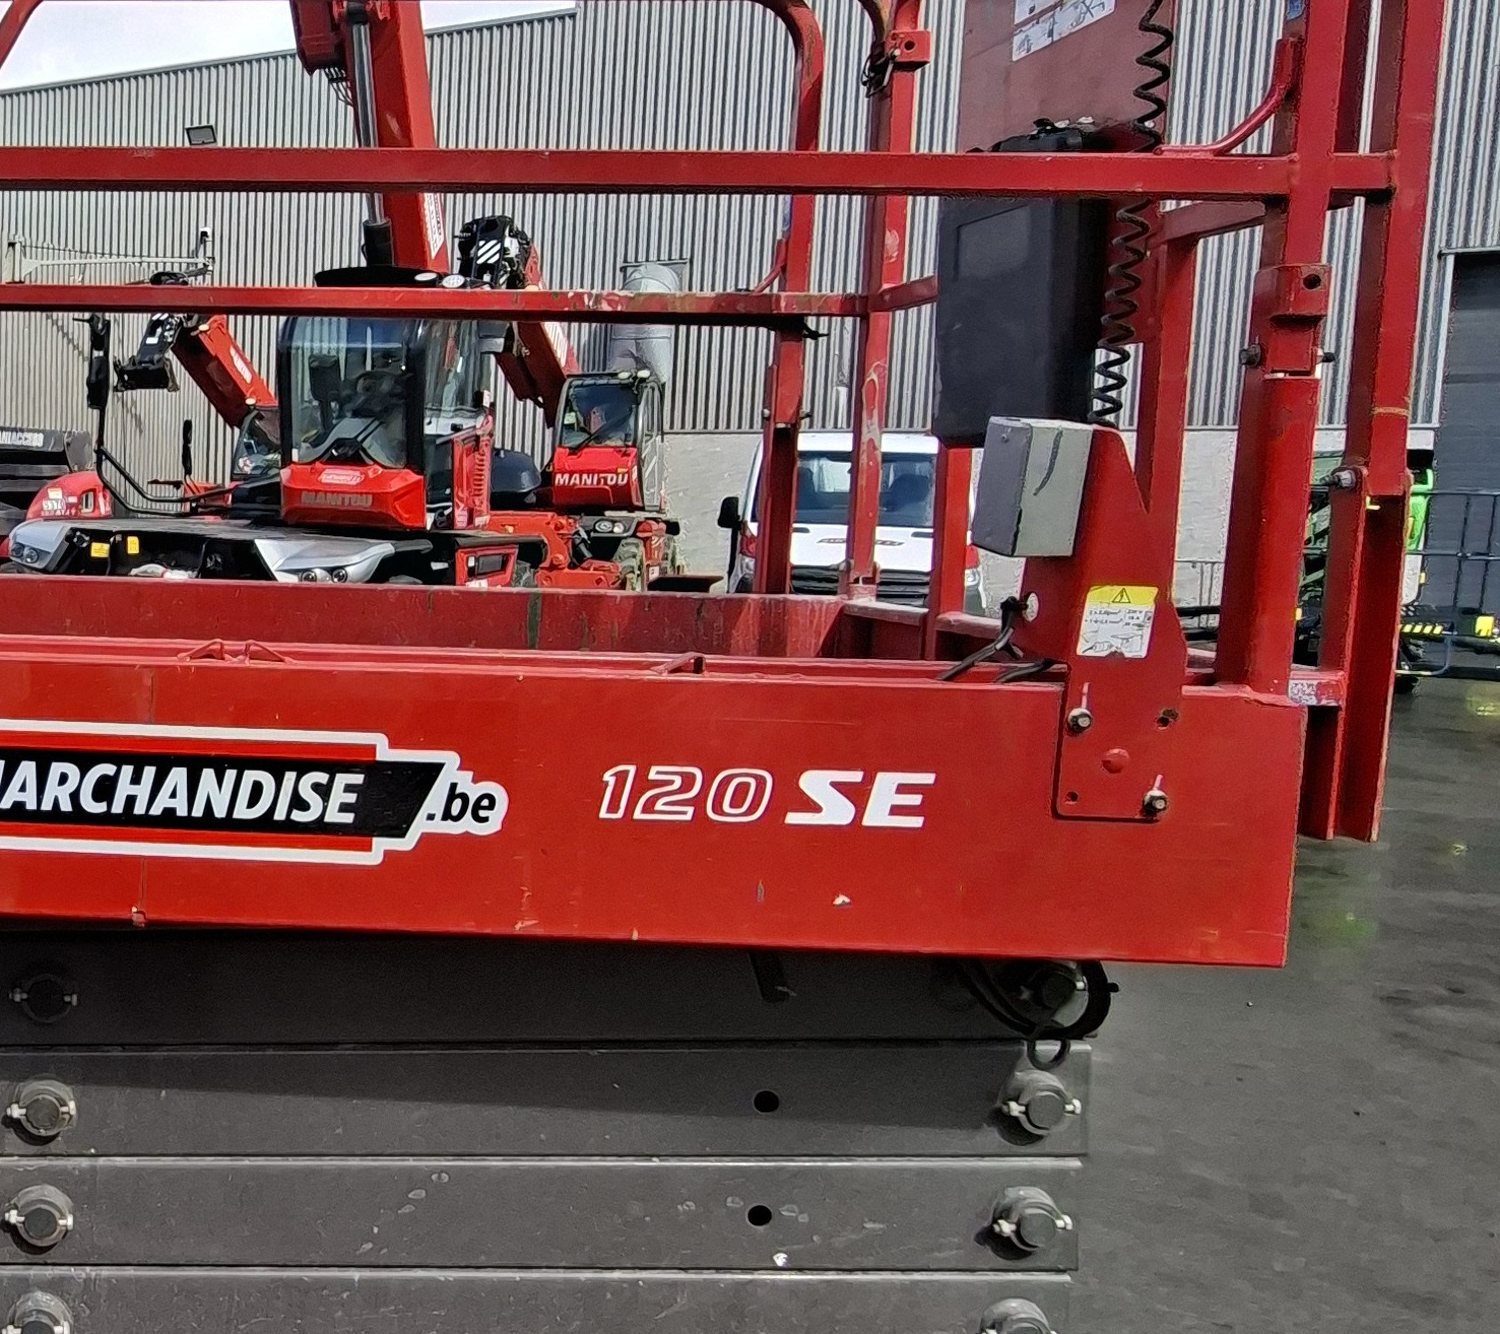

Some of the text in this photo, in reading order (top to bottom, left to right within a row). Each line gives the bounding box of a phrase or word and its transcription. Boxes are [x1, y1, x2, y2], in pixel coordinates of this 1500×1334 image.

[554, 473, 629, 486] MANITOU
[598, 764, 937, 828] 120 SE
